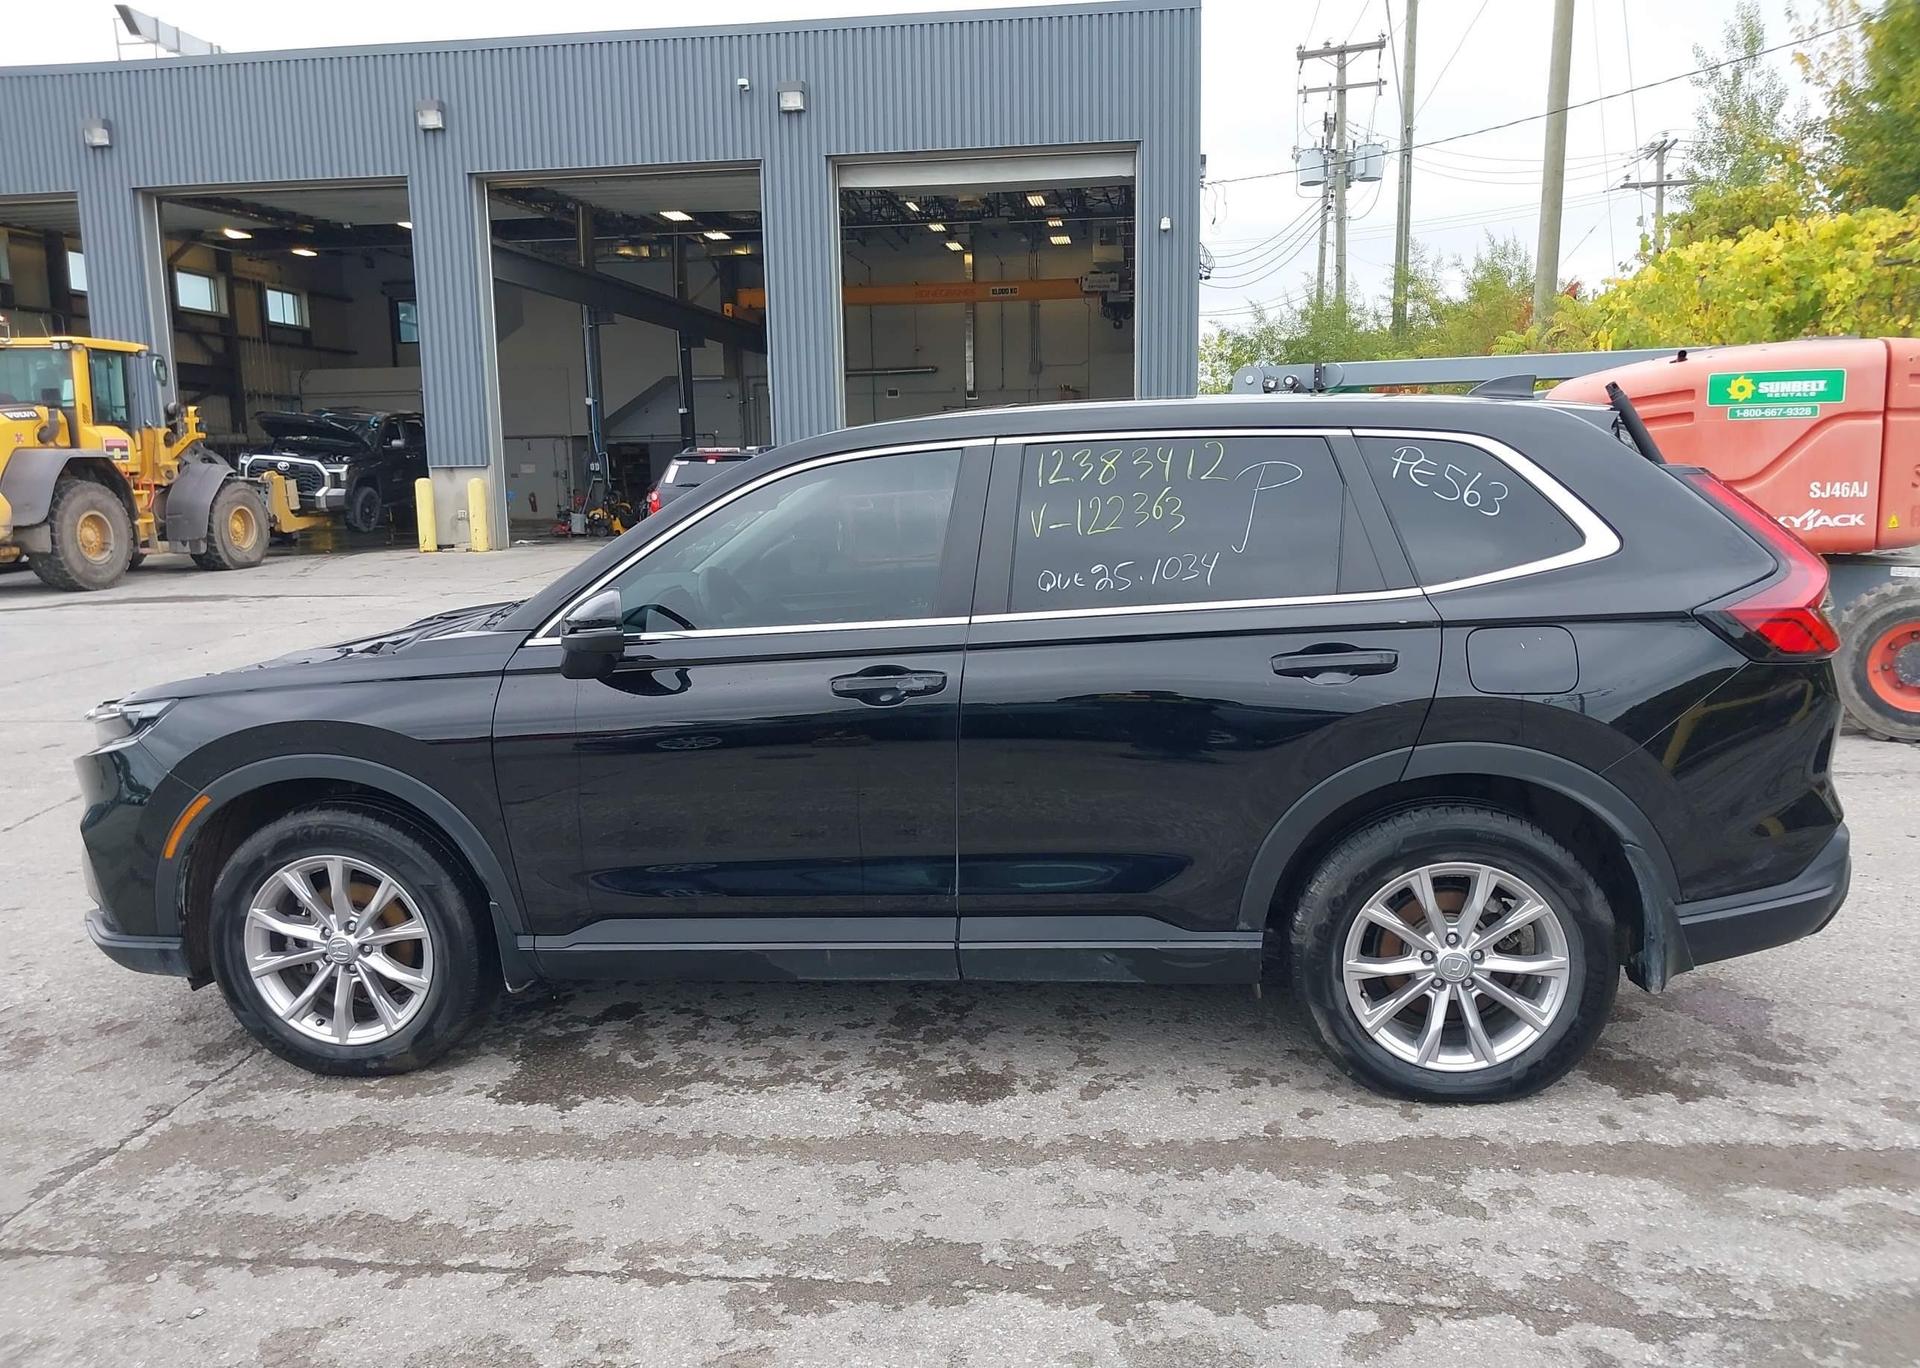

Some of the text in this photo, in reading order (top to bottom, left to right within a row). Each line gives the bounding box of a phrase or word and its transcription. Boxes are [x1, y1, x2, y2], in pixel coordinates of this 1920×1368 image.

[1758, 380, 1828, 393] SUNBELT
[1736, 407, 1812, 417] 1-800-667-9328
[1809, 481, 1869, 498] SJ46AJ
[1774, 508, 1866, 530] KYJACK
